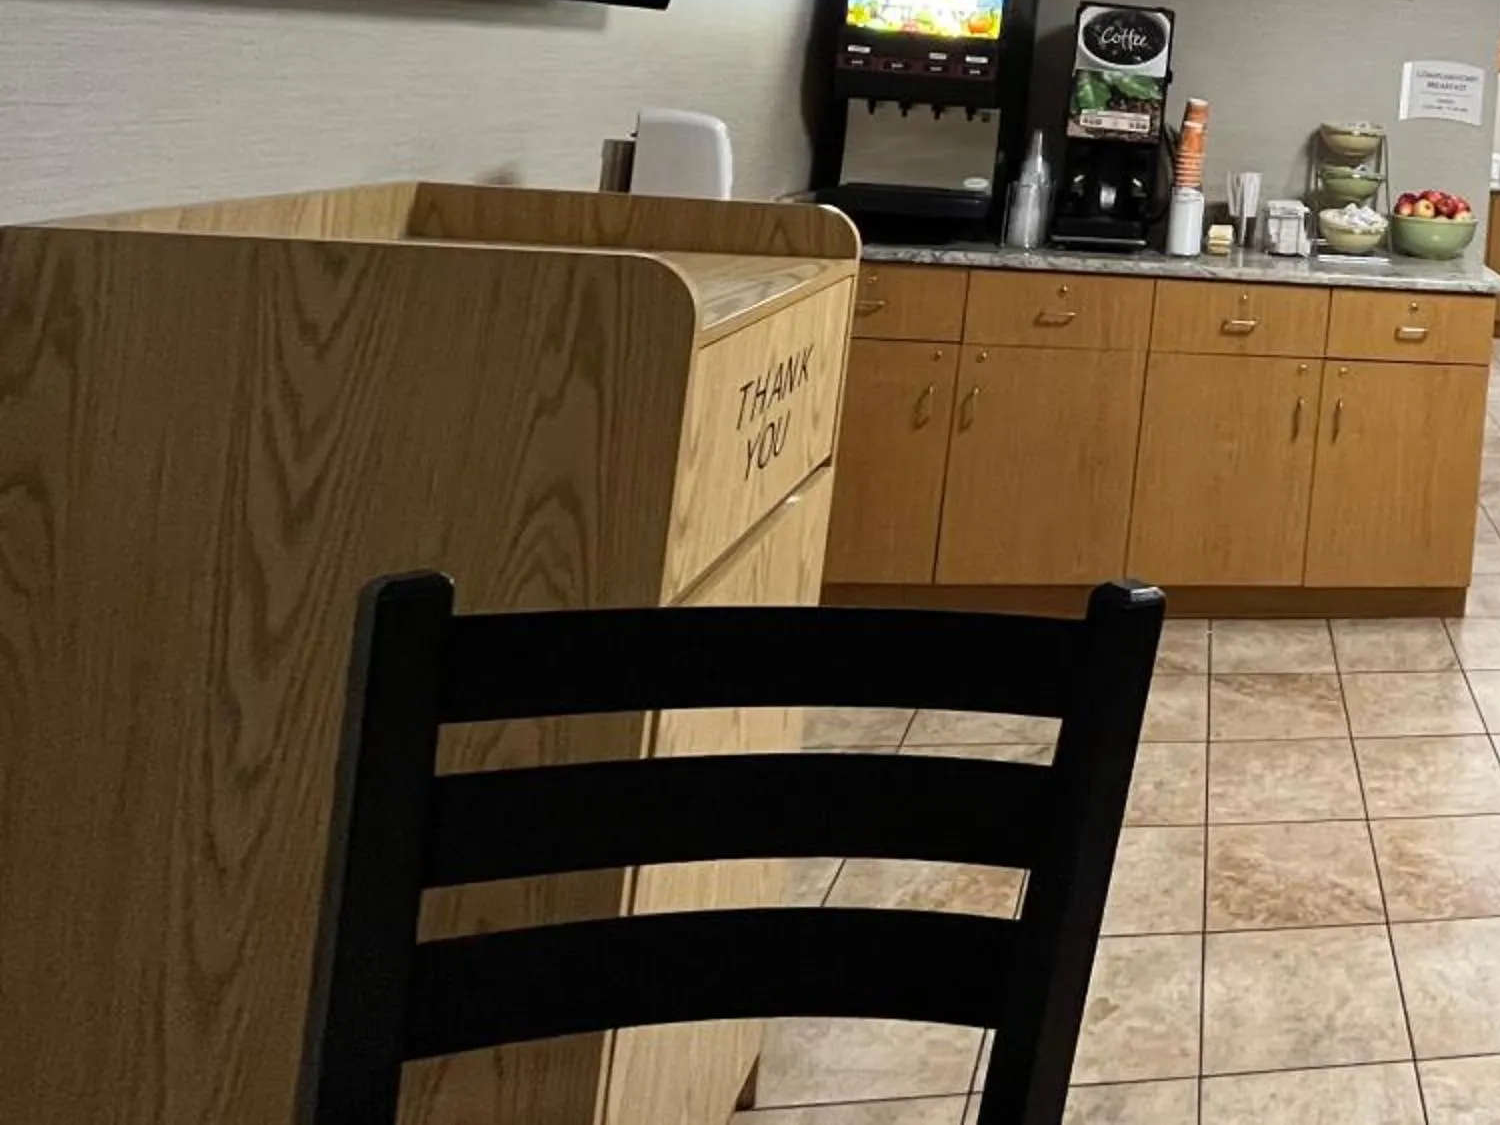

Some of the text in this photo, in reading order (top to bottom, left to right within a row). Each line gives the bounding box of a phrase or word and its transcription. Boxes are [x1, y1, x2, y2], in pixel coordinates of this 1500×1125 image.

[1101, 26, 1148, 52] Coffee
[736, 342, 815, 431] THANK
[744, 410, 791, 482] YOU
